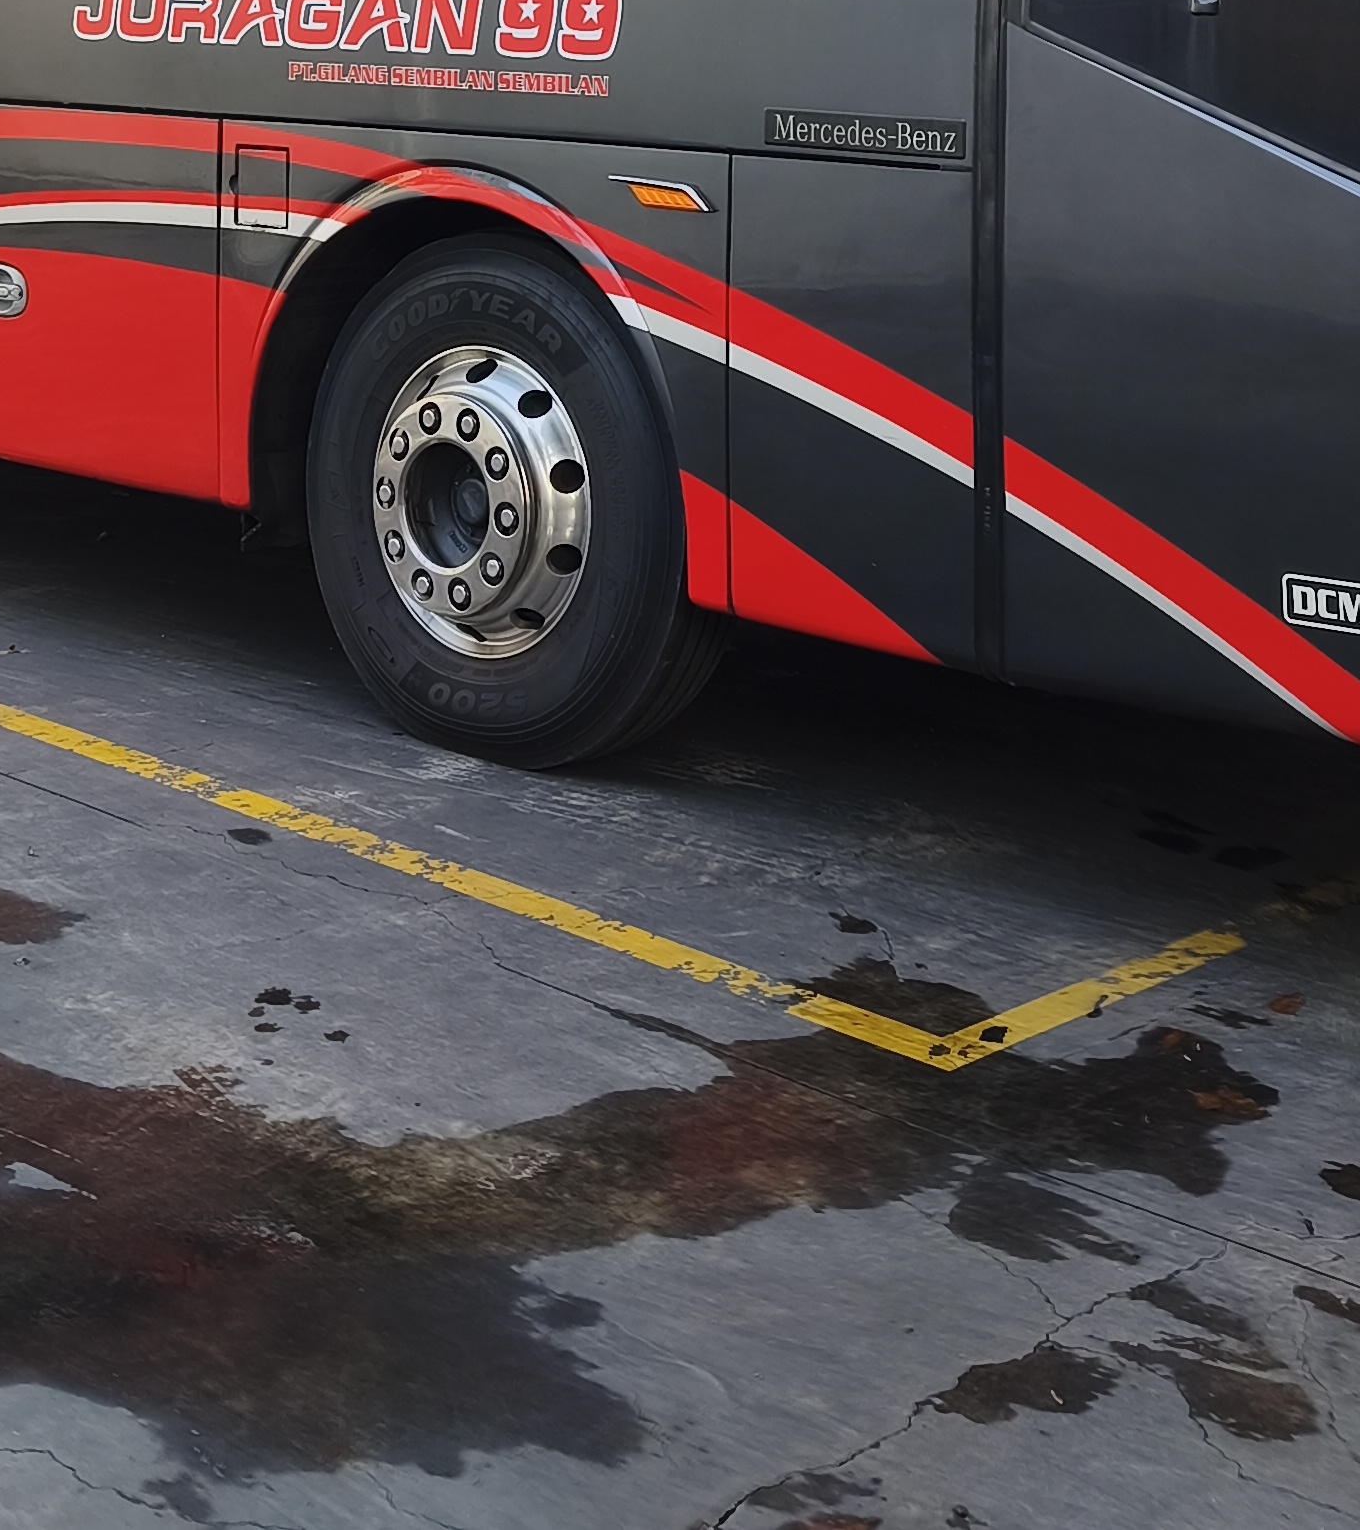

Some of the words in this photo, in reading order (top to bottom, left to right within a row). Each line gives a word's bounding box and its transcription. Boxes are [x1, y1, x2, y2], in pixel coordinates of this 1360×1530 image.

[390, 66, 493, 91] SEMBILAN
[498, 71, 609, 97] SEMBILAN
[773, 113, 956, 153] Mercedes-Benz
[370, 287, 563, 362] GOODYEAR
